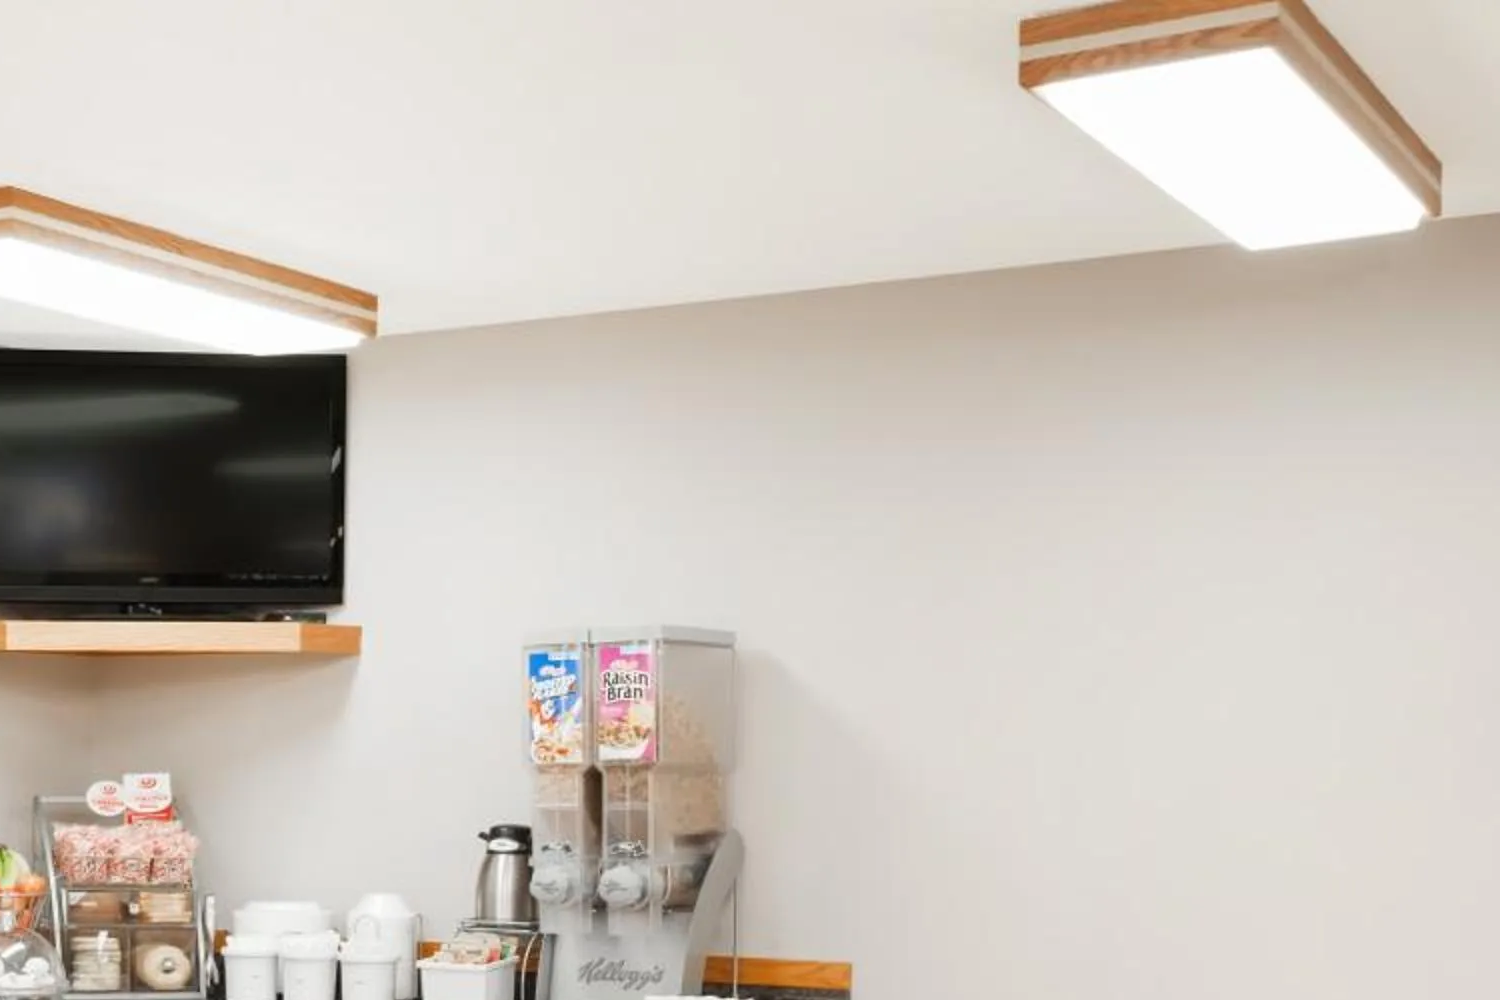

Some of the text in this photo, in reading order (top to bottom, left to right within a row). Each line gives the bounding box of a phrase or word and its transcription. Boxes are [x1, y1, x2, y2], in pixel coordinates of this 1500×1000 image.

[603, 671, 650, 689] Raisin
[606, 685, 644, 702] Bran
[577, 956, 664, 991] Kellogg's
